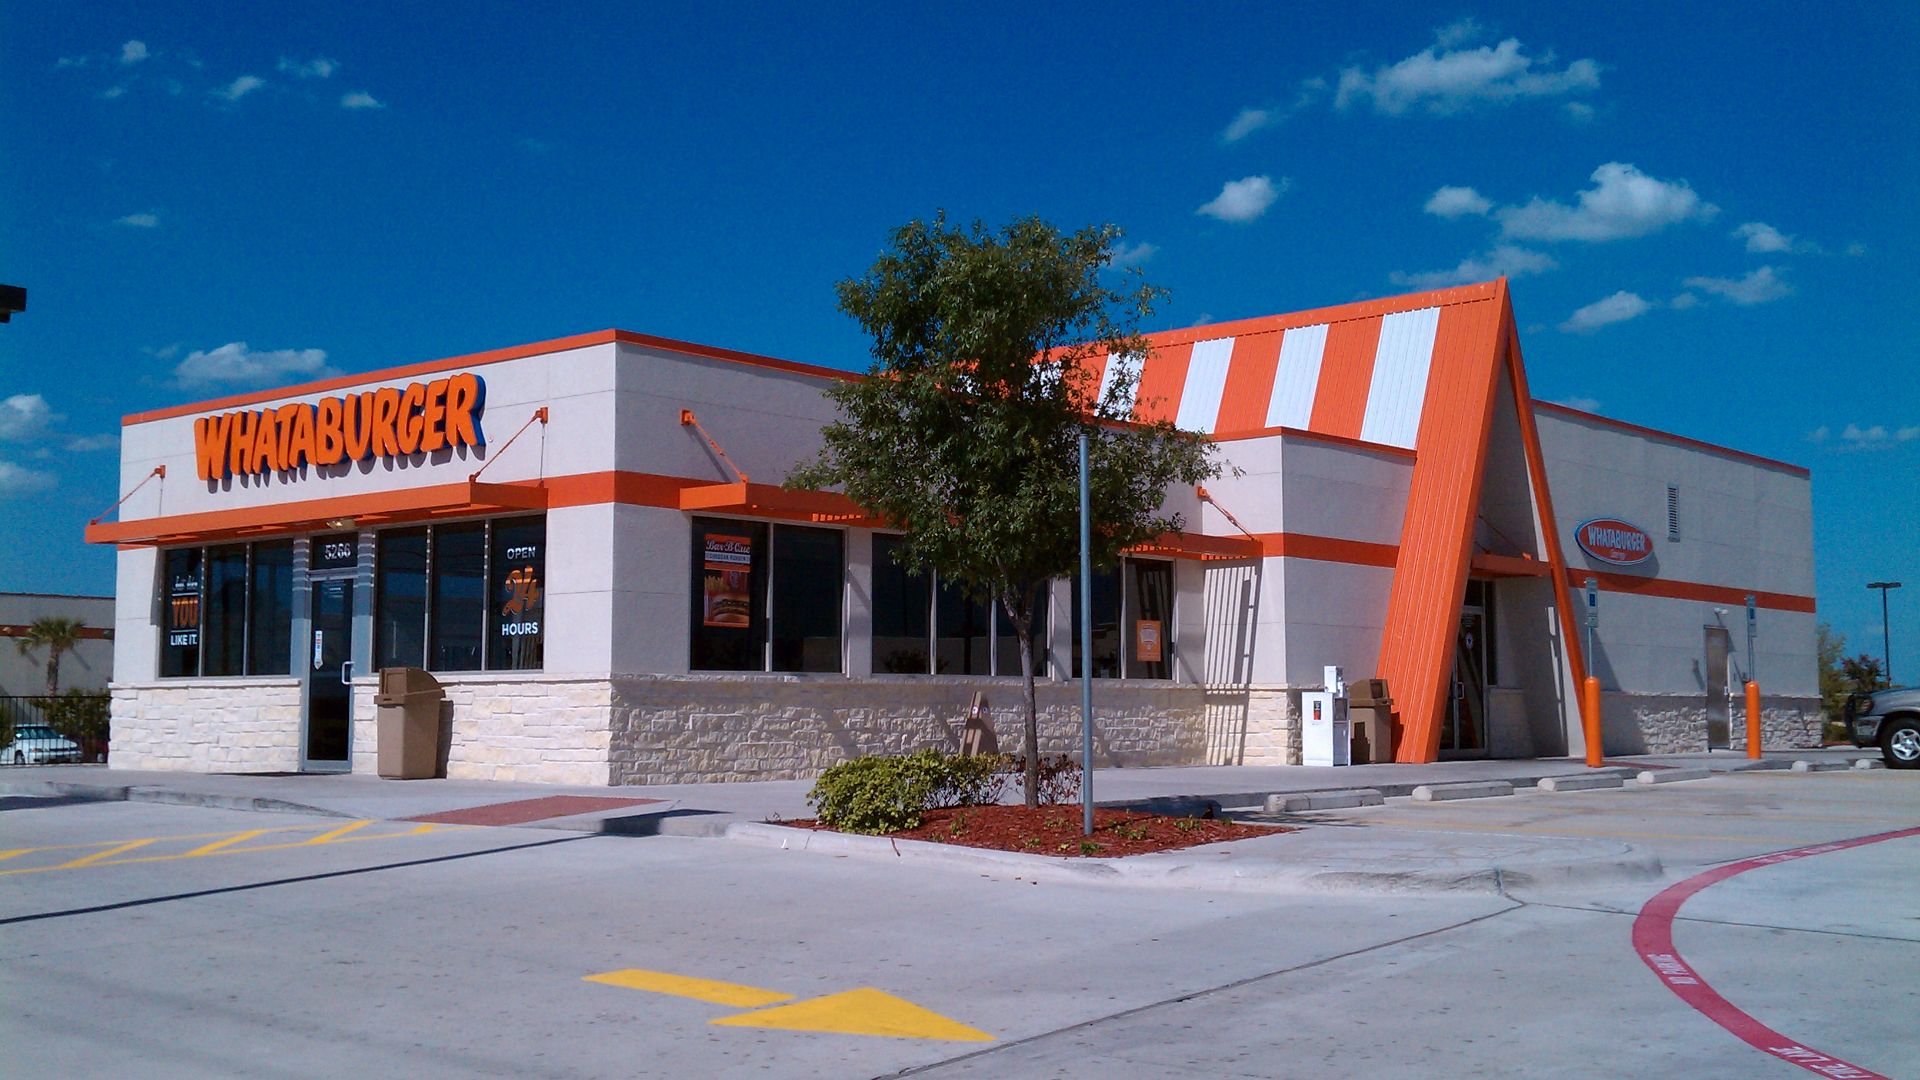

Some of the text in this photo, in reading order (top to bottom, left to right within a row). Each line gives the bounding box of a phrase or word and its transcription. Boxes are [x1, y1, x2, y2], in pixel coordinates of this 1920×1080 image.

[194, 372, 486, 481] WHATABURGER
[1587, 525, 1645, 553] WHATABURGER
[324, 543, 351, 560] 5266
[506, 546, 536, 560] OPEN
[502, 566, 540, 616] 24
[172, 597, 198, 628] YOU
[501, 621, 539, 636] HOURS
[171, 634, 188, 646] LIKE
